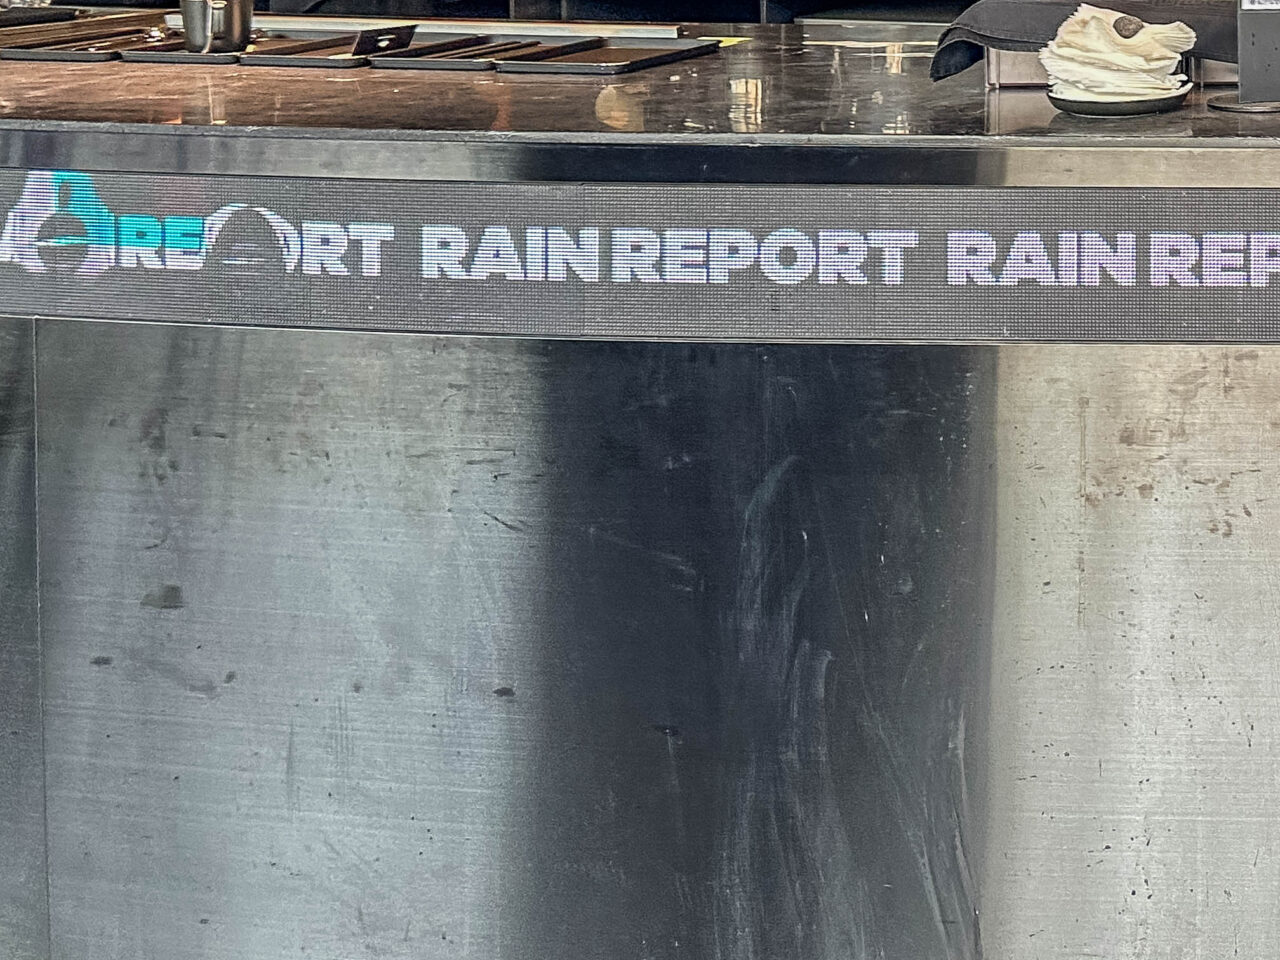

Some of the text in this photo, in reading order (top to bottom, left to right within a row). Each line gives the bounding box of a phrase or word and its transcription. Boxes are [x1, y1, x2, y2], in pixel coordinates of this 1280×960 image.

[421, 224, 600, 283] RAIN
[611, 227, 919, 285] REPORT
[946, 230, 1135, 287] RAIN
